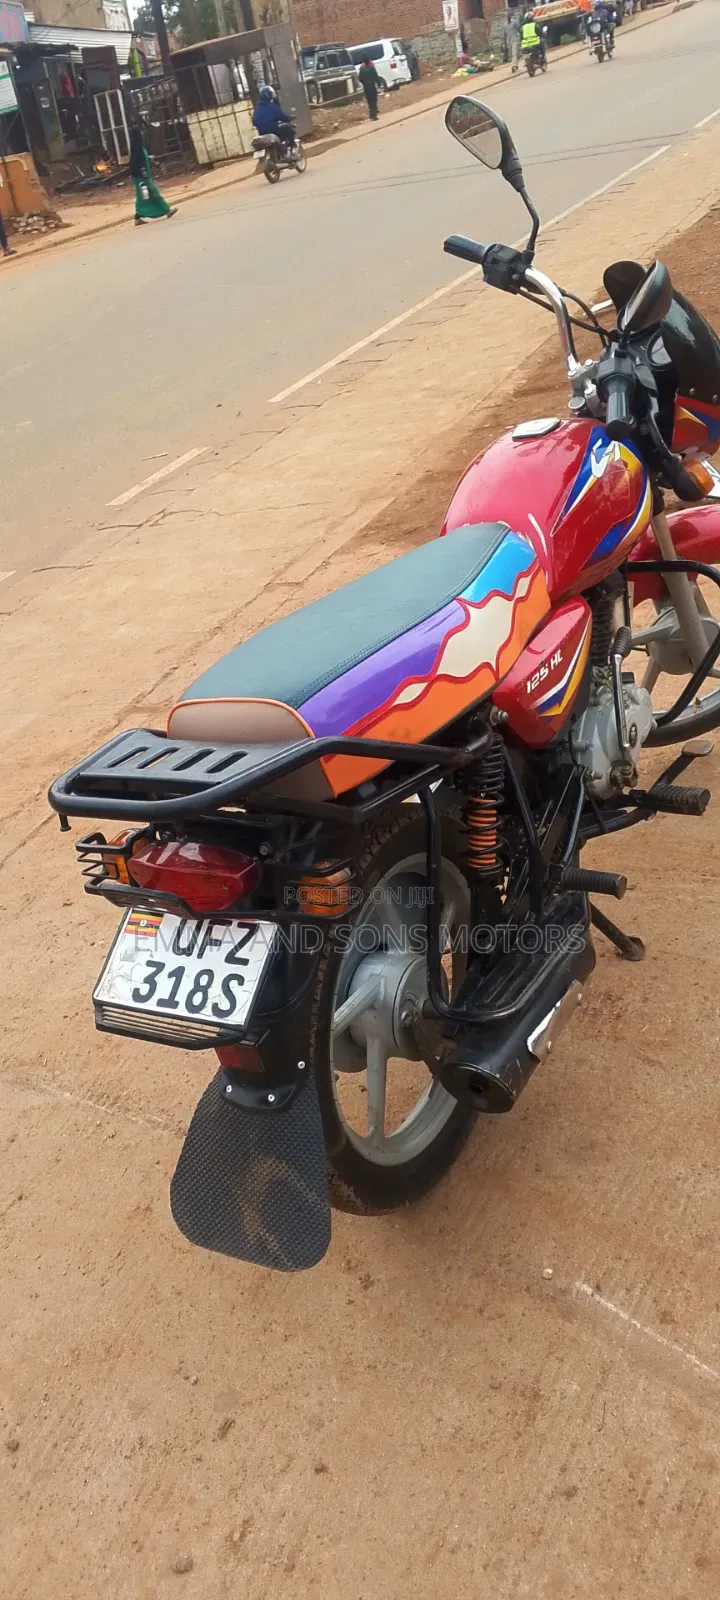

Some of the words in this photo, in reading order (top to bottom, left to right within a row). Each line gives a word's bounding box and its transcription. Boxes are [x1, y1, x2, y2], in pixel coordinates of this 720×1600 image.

[527, 663, 549, 694] 125
[172, 918, 260, 966] UFZ
[132, 959, 246, 1019] 318S
